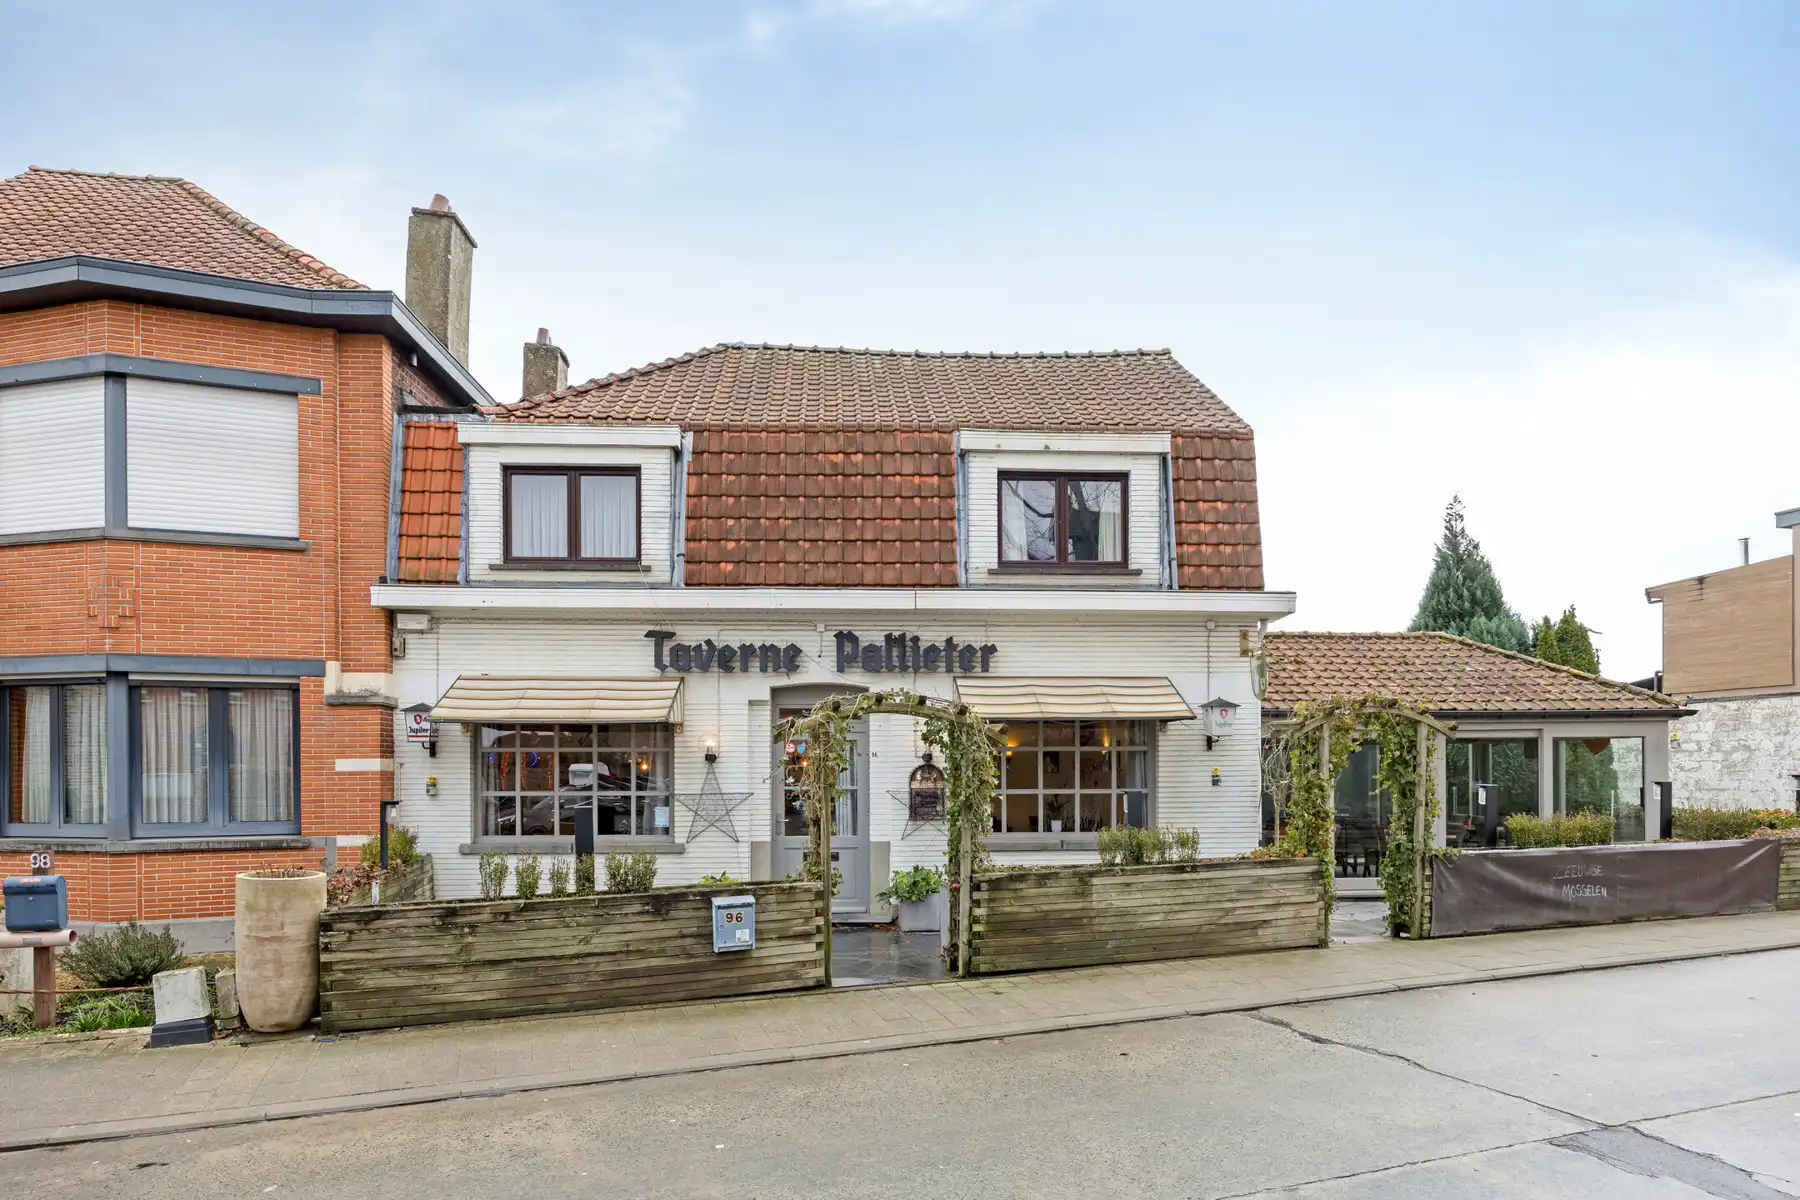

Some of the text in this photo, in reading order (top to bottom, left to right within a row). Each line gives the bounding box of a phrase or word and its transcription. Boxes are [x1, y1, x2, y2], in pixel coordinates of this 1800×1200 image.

[643, 629, 998, 674] Taverne Pallieter
[409, 726, 429, 735] Jupiler
[30, 853, 50, 868] 98
[1562, 884, 1607, 900] MOSSELEN
[725, 912, 743, 923] 96
